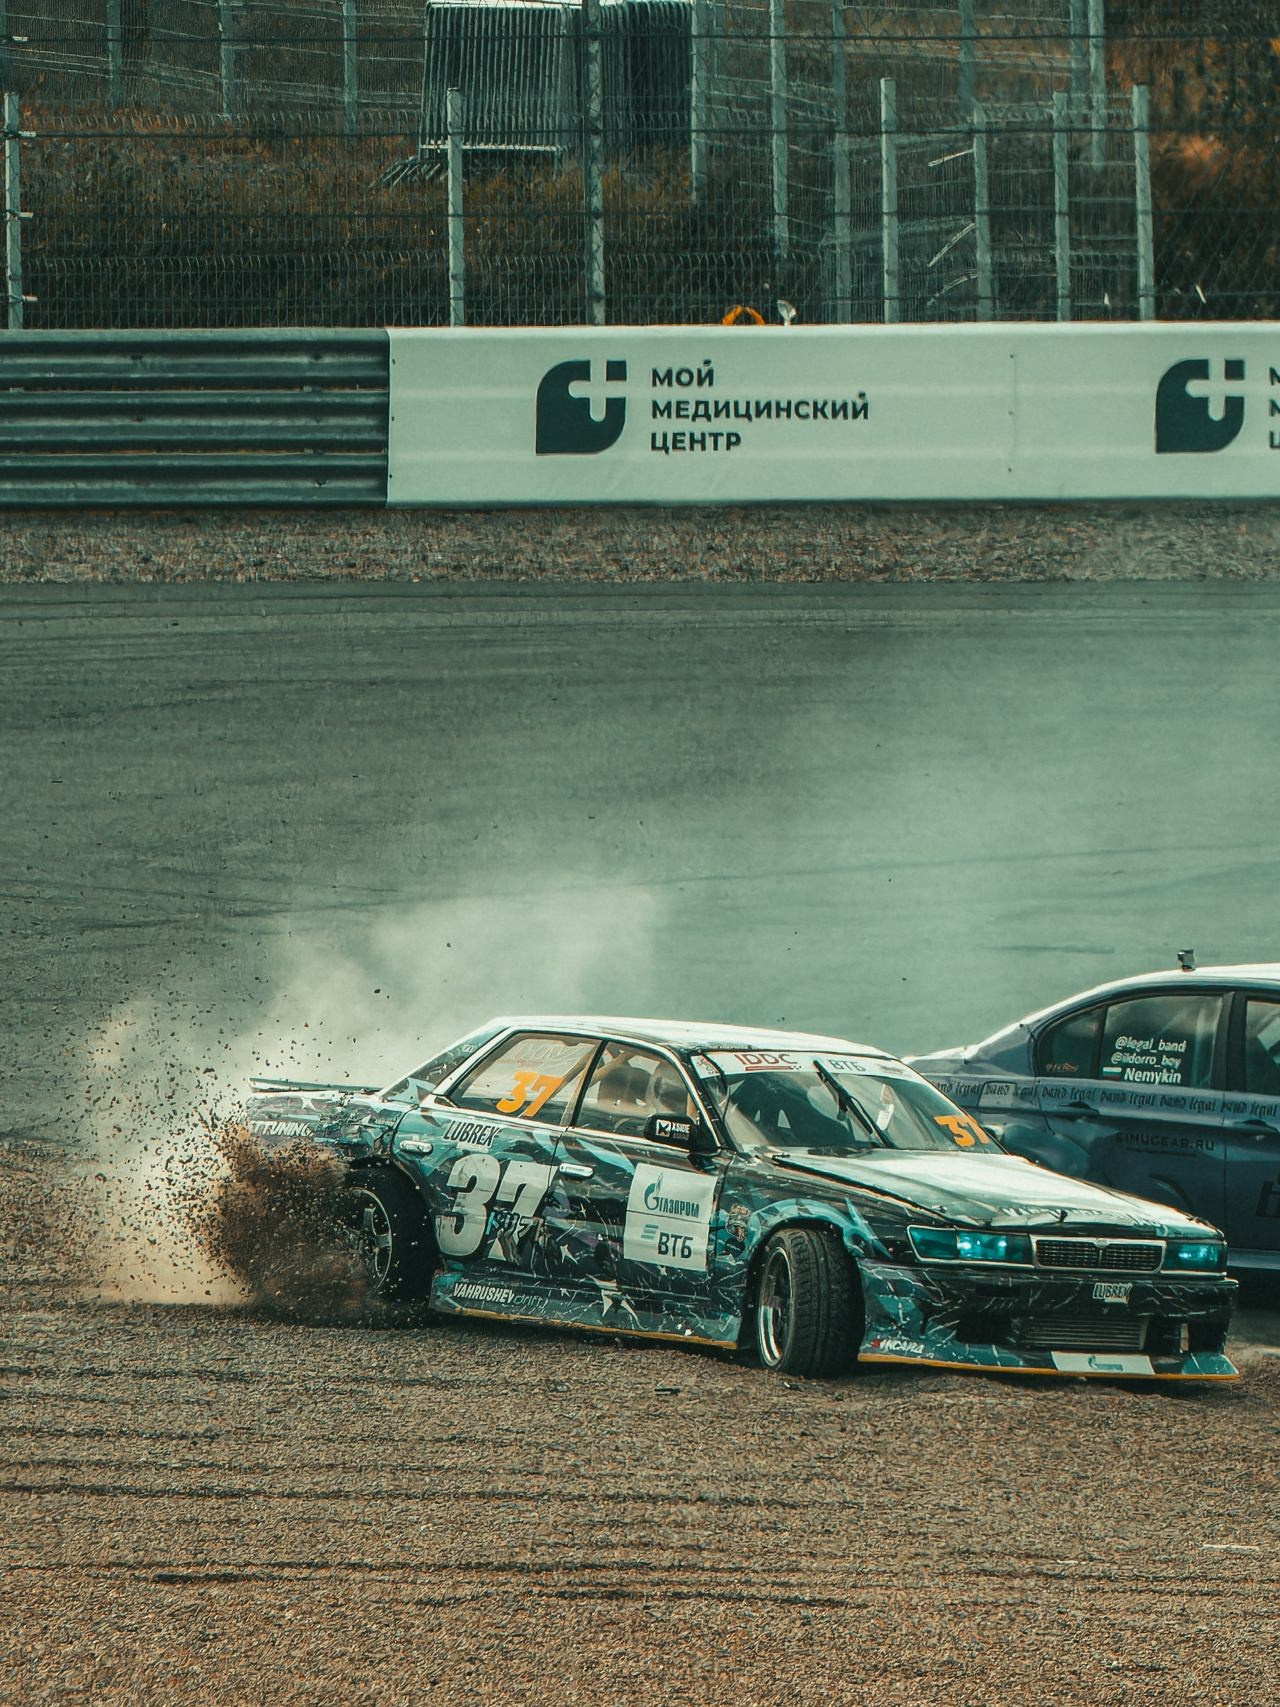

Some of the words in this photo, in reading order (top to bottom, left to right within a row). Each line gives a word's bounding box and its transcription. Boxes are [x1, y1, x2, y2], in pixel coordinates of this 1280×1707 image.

[651, 359, 714, 387] МОЙ
[651, 391, 869, 422] МЕДИЦИНСКИЙ
[651, 432, 742, 455] ЦЕНТР
[734, 1054, 798, 1066] IDDC
[1124, 1067, 1181, 1086] Nemykin
[496, 1072, 565, 1117] 37
[443, 1121, 500, 1147] LUBREX
[435, 1154, 560, 1262] 37
[659, 1197, 700, 1218] ГАЗПРОМ
[658, 1232, 694, 1259] ВТБ
[453, 1282, 515, 1304] VAHRUSHEV
